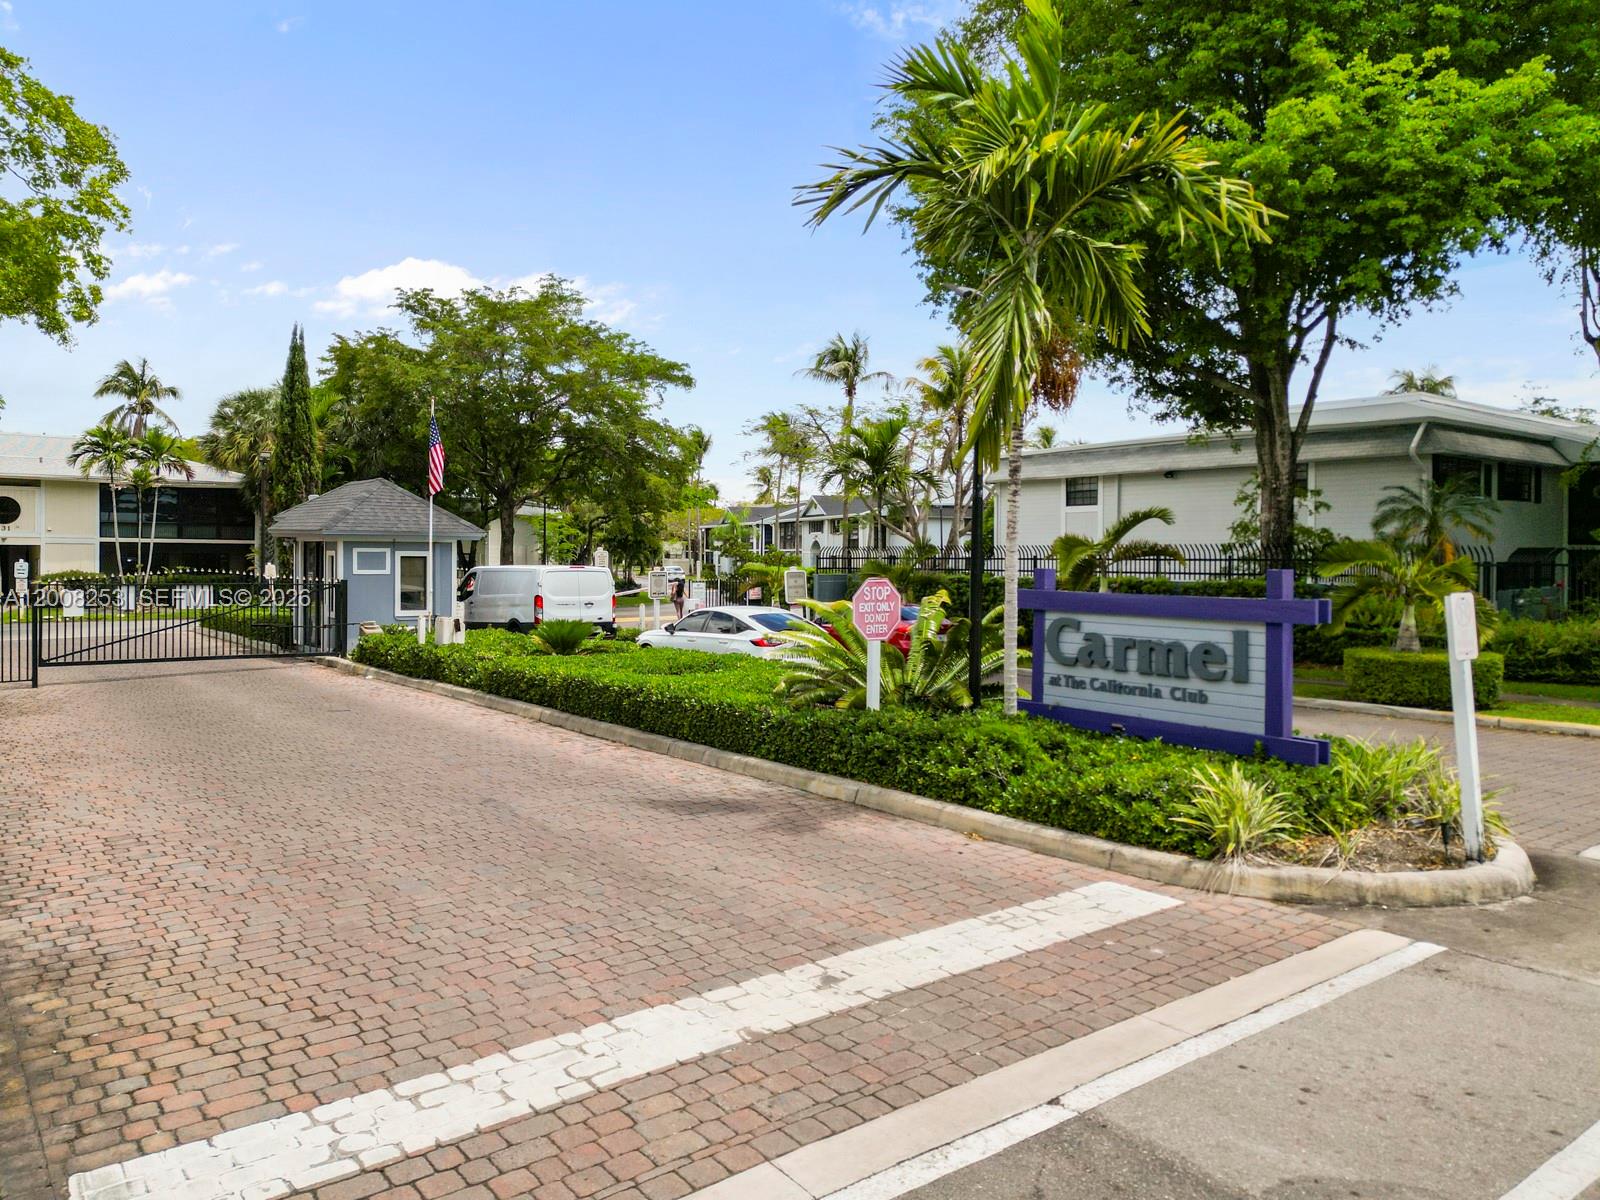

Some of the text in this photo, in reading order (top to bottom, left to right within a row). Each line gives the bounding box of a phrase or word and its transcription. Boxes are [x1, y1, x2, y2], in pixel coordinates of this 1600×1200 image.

[864, 587, 891, 600] STOP
[859, 602, 895, 612] EXIT ONLY
[865, 613, 889, 623] DO NOT
[866, 624, 888, 633] ENTER
[1045, 617, 1250, 684] Carmel
[1049, 675, 1209, 705] at The California Club
